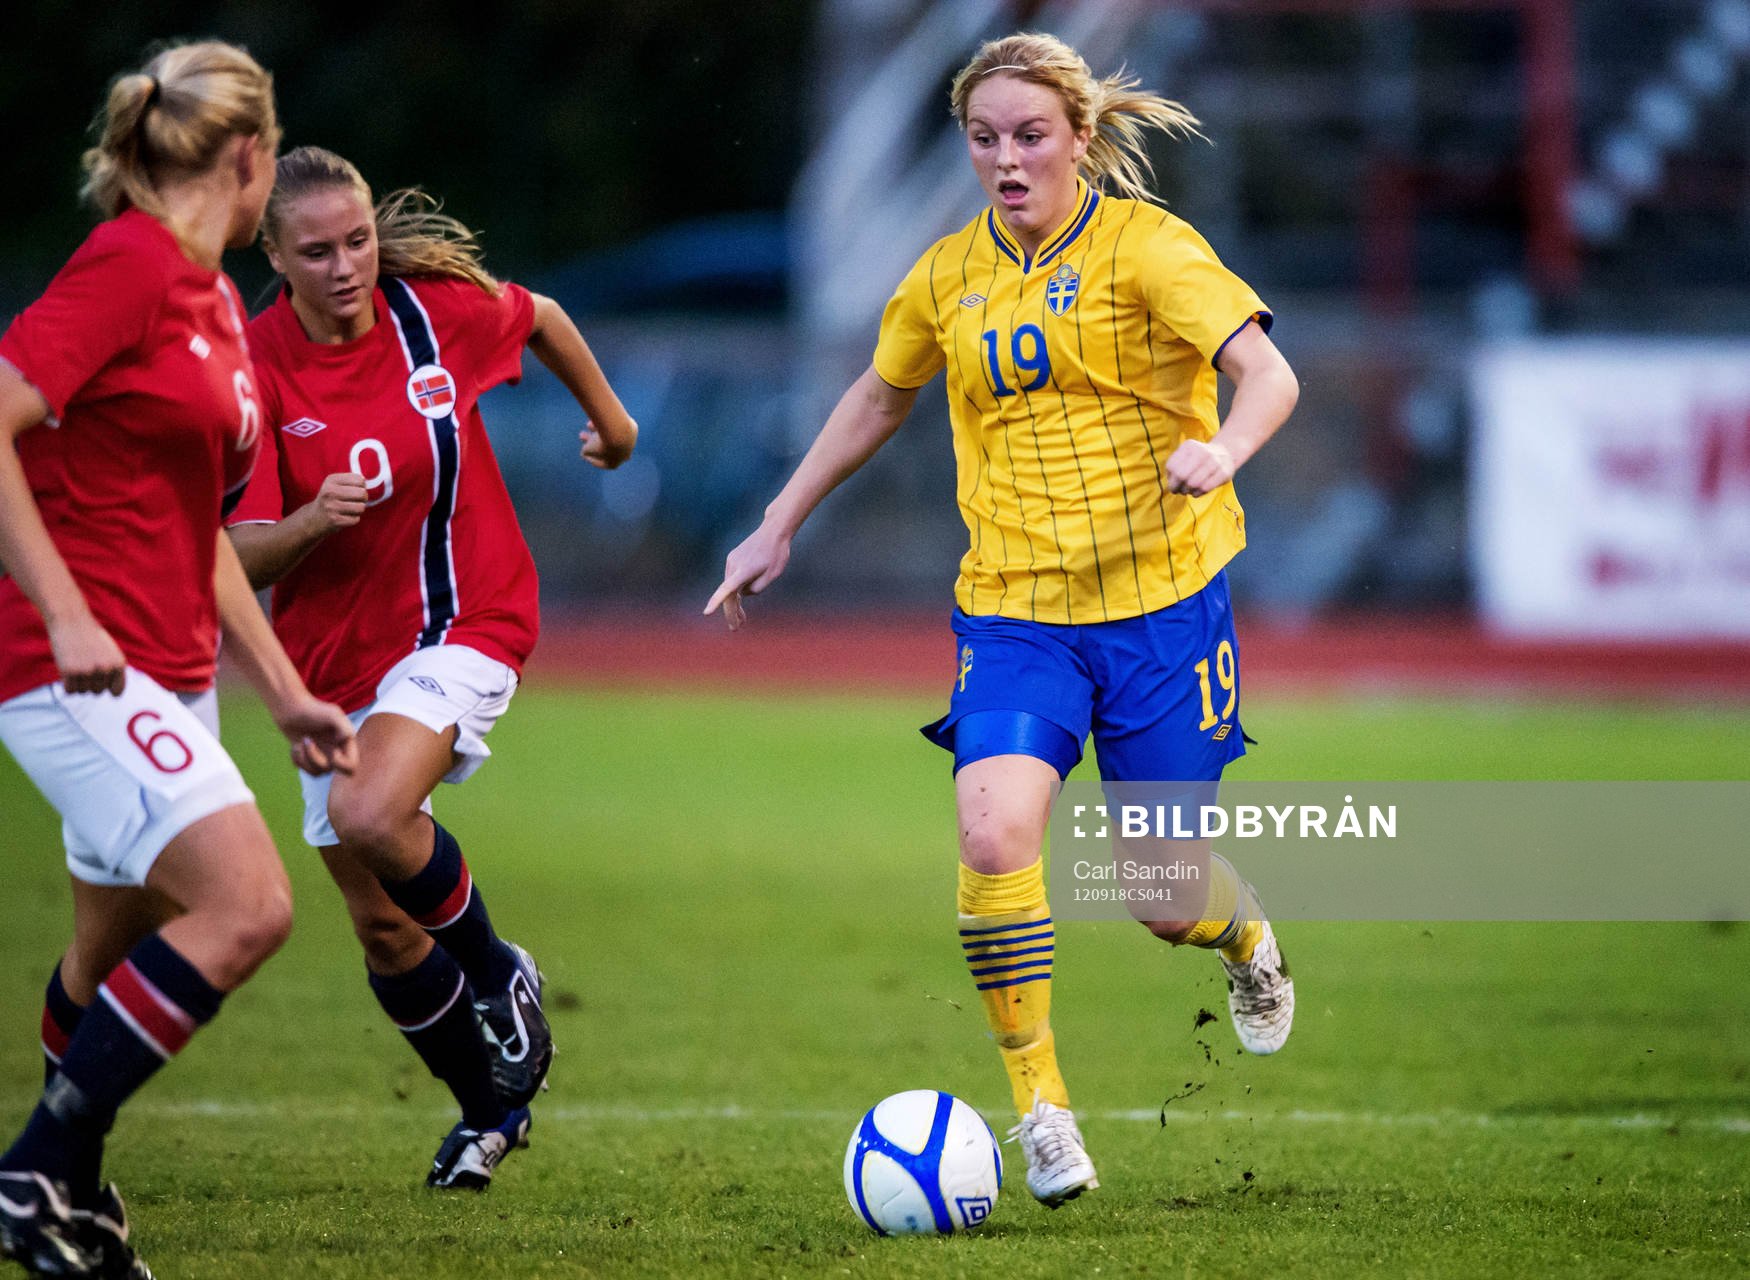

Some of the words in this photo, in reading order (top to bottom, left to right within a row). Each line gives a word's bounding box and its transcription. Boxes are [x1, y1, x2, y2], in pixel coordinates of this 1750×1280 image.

[982, 323, 1051, 397] 19
[232, 370, 260, 451] 6
[349, 438, 394, 507] 9
[1194, 640, 1236, 731] 19
[126, 710, 193, 774] 6
